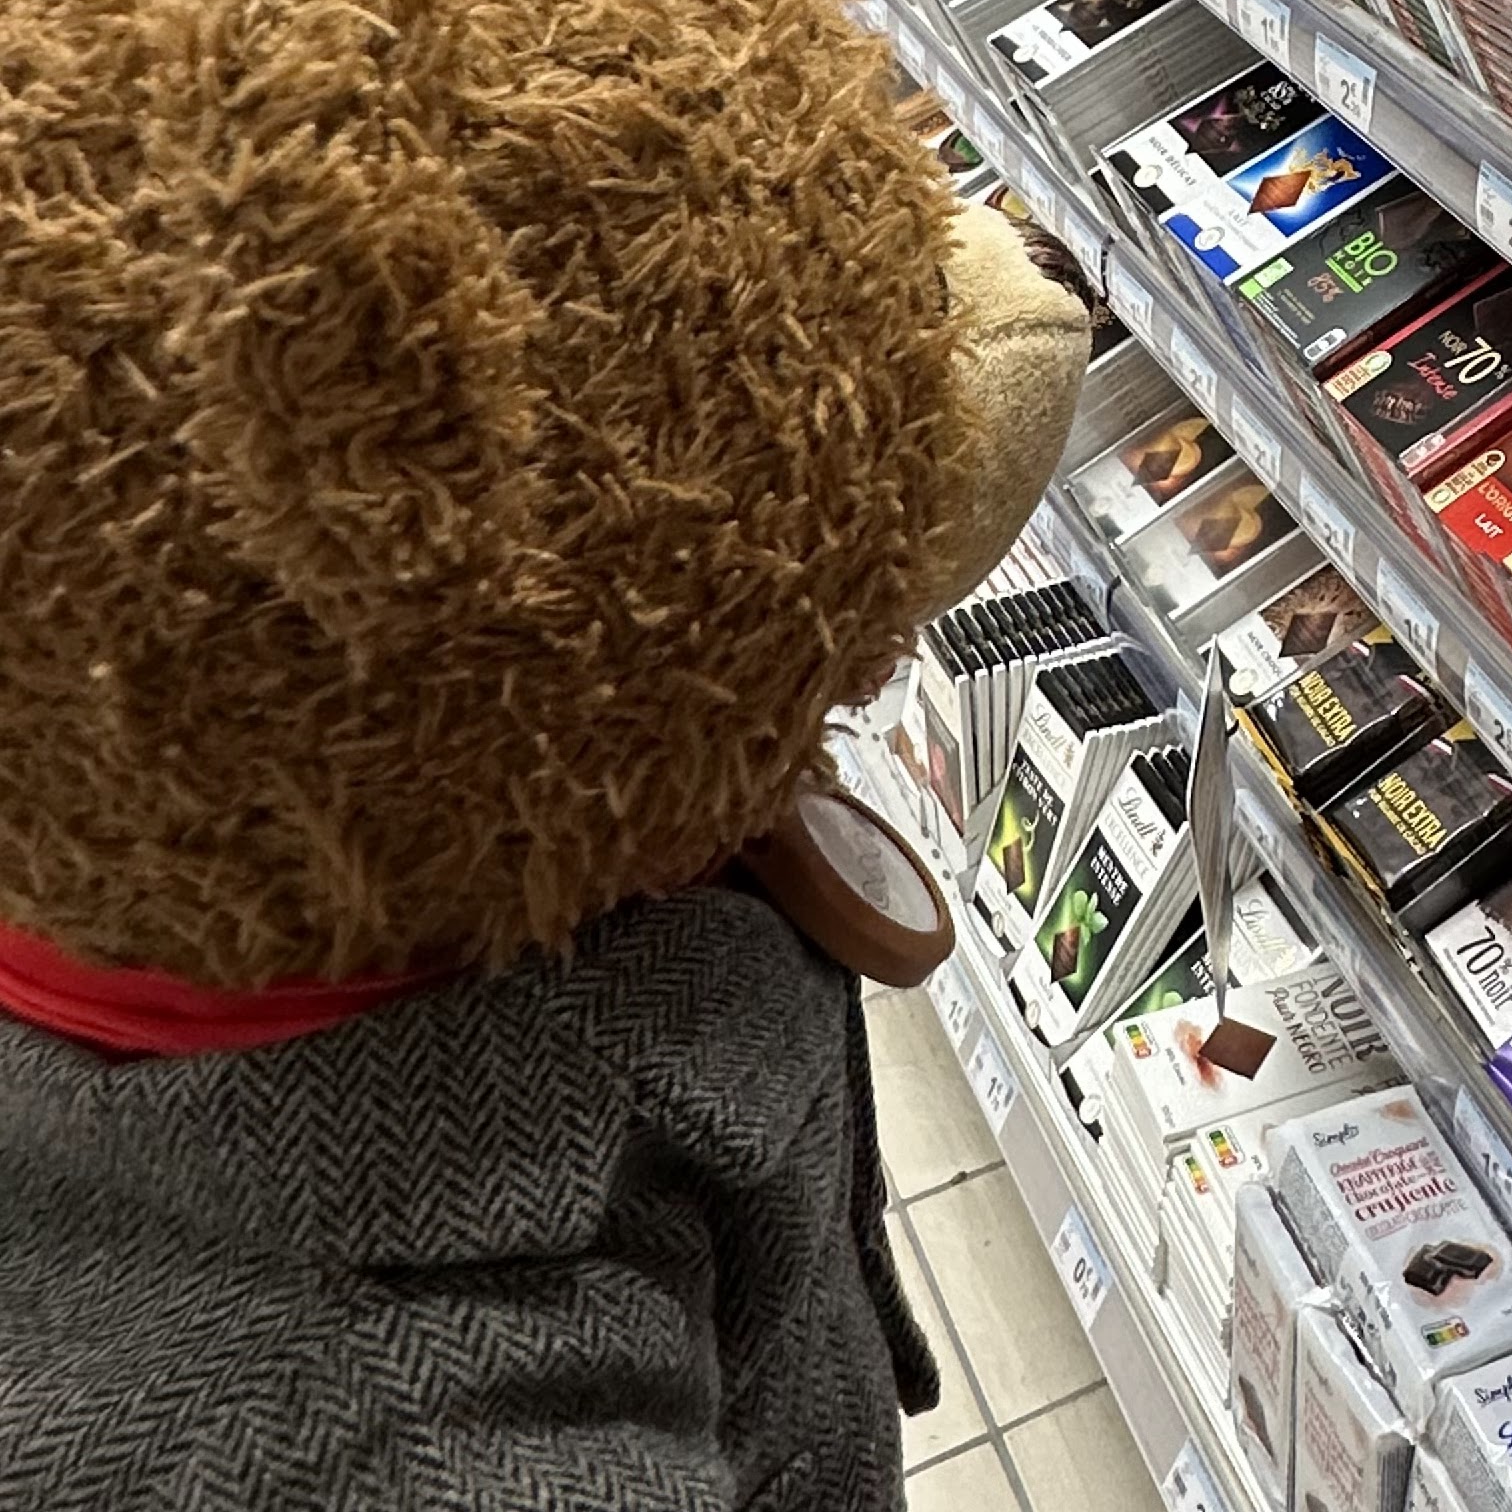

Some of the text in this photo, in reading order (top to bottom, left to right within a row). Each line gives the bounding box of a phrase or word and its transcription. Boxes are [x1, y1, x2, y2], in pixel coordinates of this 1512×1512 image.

[1344, 230, 1399, 276] BIO
[1473, 512, 1505, 539] LAIT
[1318, 697, 1358, 742] EXTRA
[1401, 800, 1448, 850] EXTRA
[1285, 1021, 1327, 1076] NEGRO
[1289, 979, 1354, 1073] FONDENTE
[1354, 1175, 1458, 1223] crujiente
